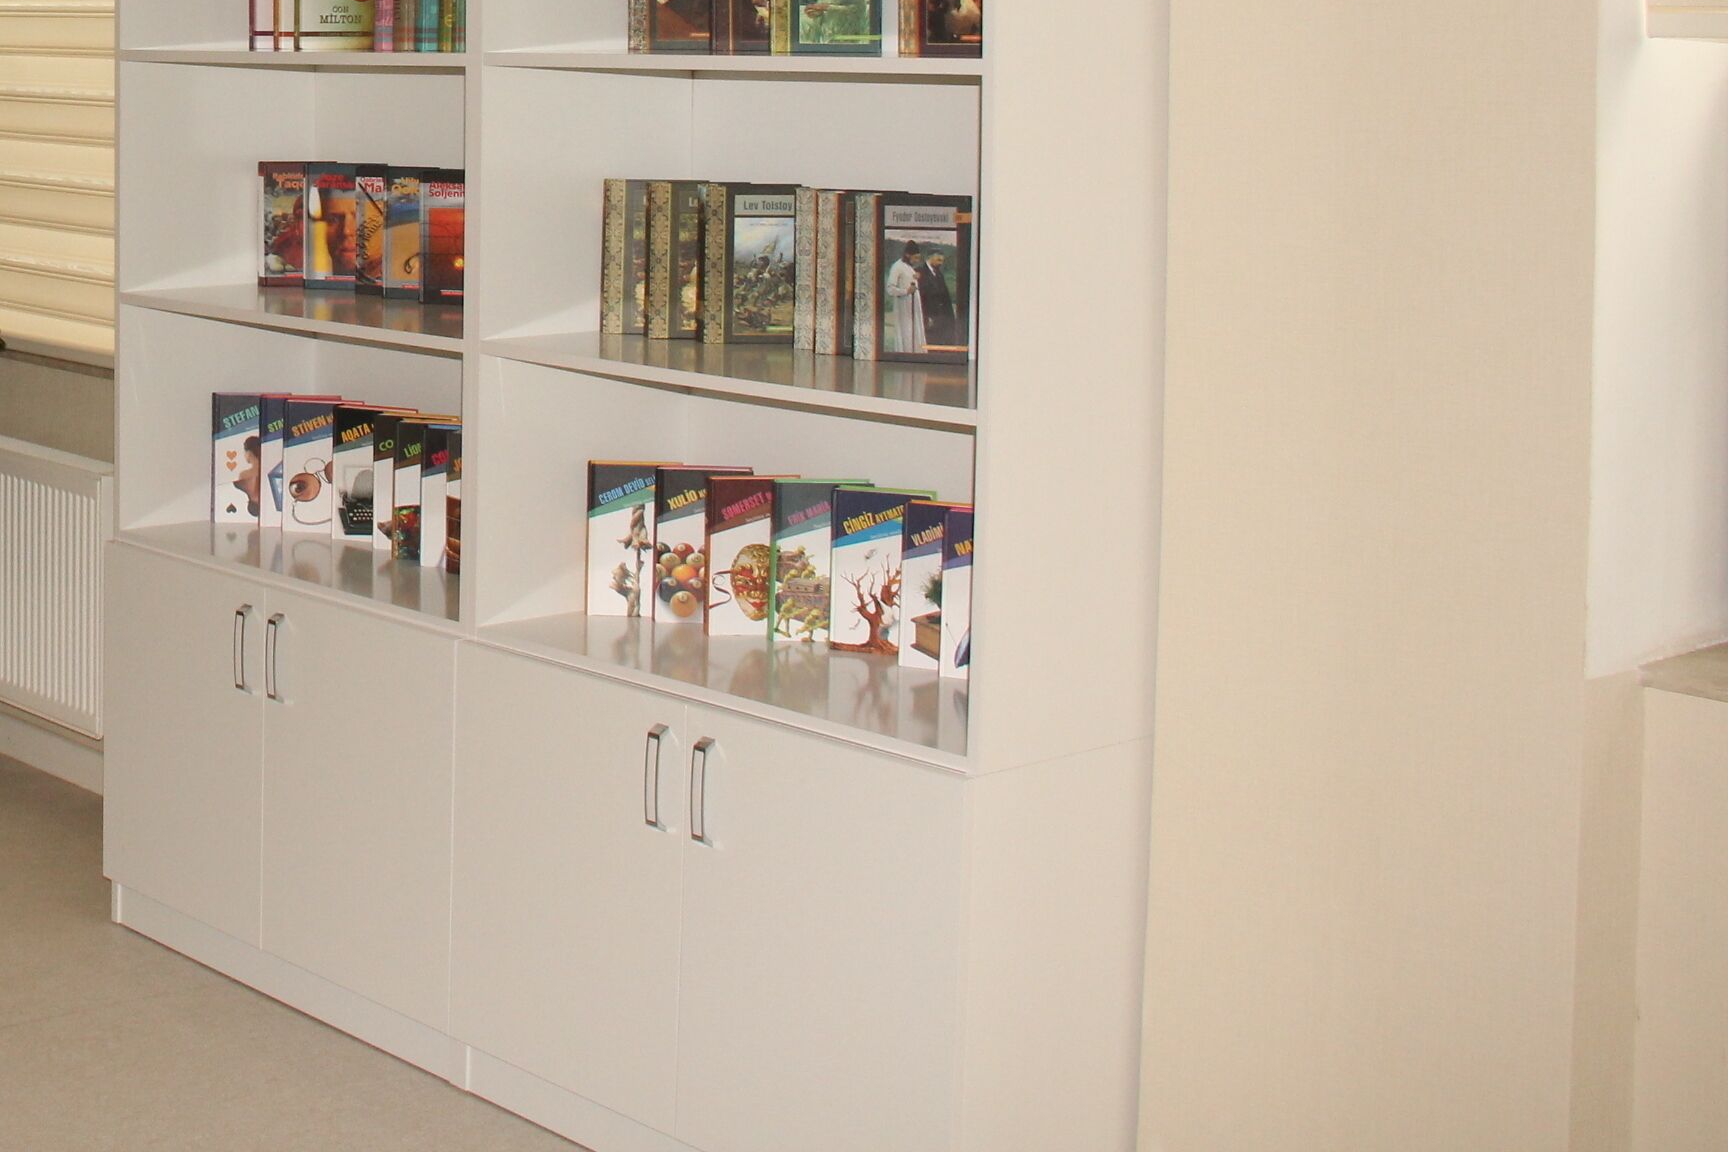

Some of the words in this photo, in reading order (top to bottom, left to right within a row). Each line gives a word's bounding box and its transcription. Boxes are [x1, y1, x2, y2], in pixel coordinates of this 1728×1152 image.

[320, 13, 362, 24] MİLTON
[364, 183, 385, 193] Ma
[743, 201, 758, 210] Lev
[762, 201, 793, 211] Tolstoy
[341, 422, 371, 444] AQATA
[623, 476, 645, 495] DEVİD
[667, 488, 698, 511] XULİO
[721, 491, 763, 520] SOMERSET
[954, 538, 973, 557] NA
